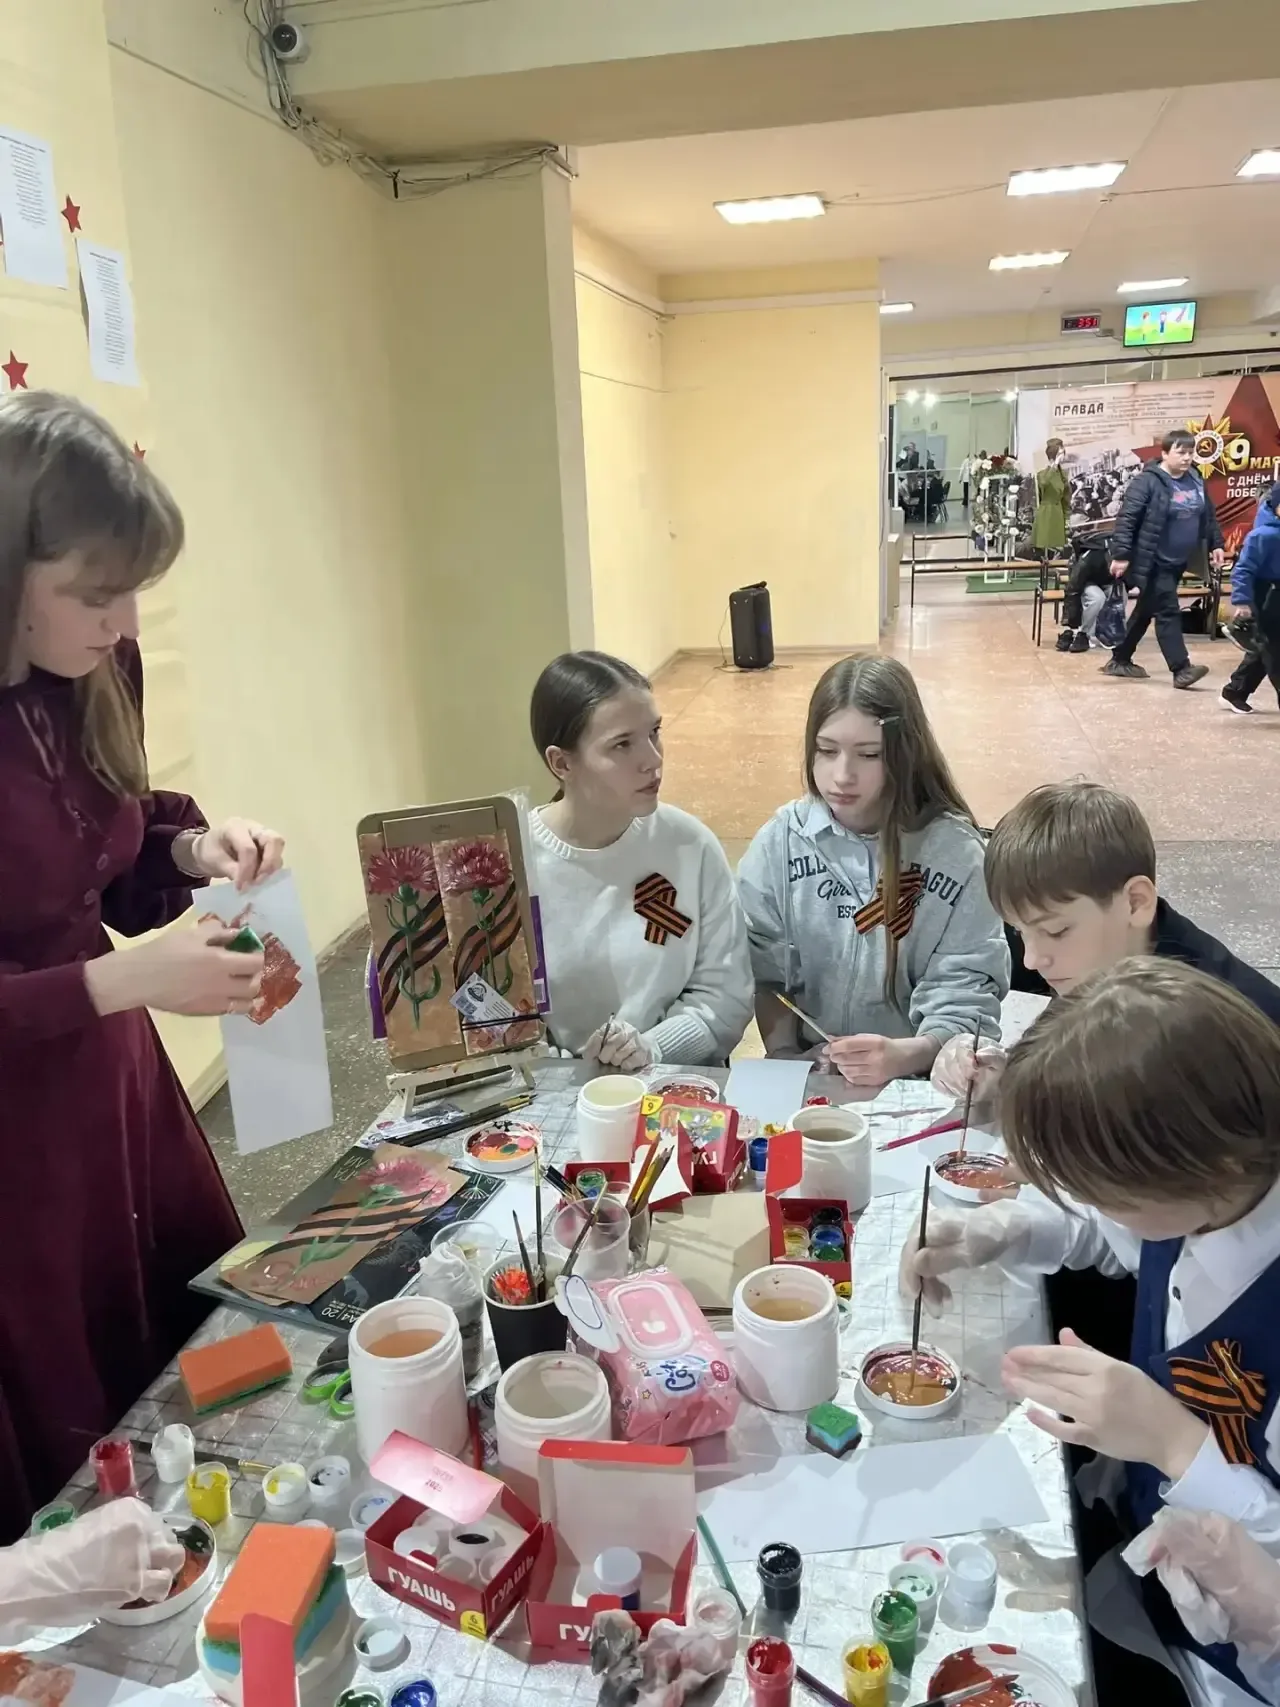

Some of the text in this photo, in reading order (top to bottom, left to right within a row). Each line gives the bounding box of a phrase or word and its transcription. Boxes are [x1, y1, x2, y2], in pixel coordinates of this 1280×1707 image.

[1054, 402, 1104, 417] ПРАВДА
[1229, 438, 1251, 471] 9
[1227, 472, 1271, 488] С ДНЁМ
[1226, 487, 1258, 499] ПОБЕ
[788, 855, 828, 883] COLL
[647, 1102, 654, 1112] 9
[387, 1555, 534, 1613] ГУАШЬ ГУАШЬ
[559, 1623, 593, 1642] ГУ
